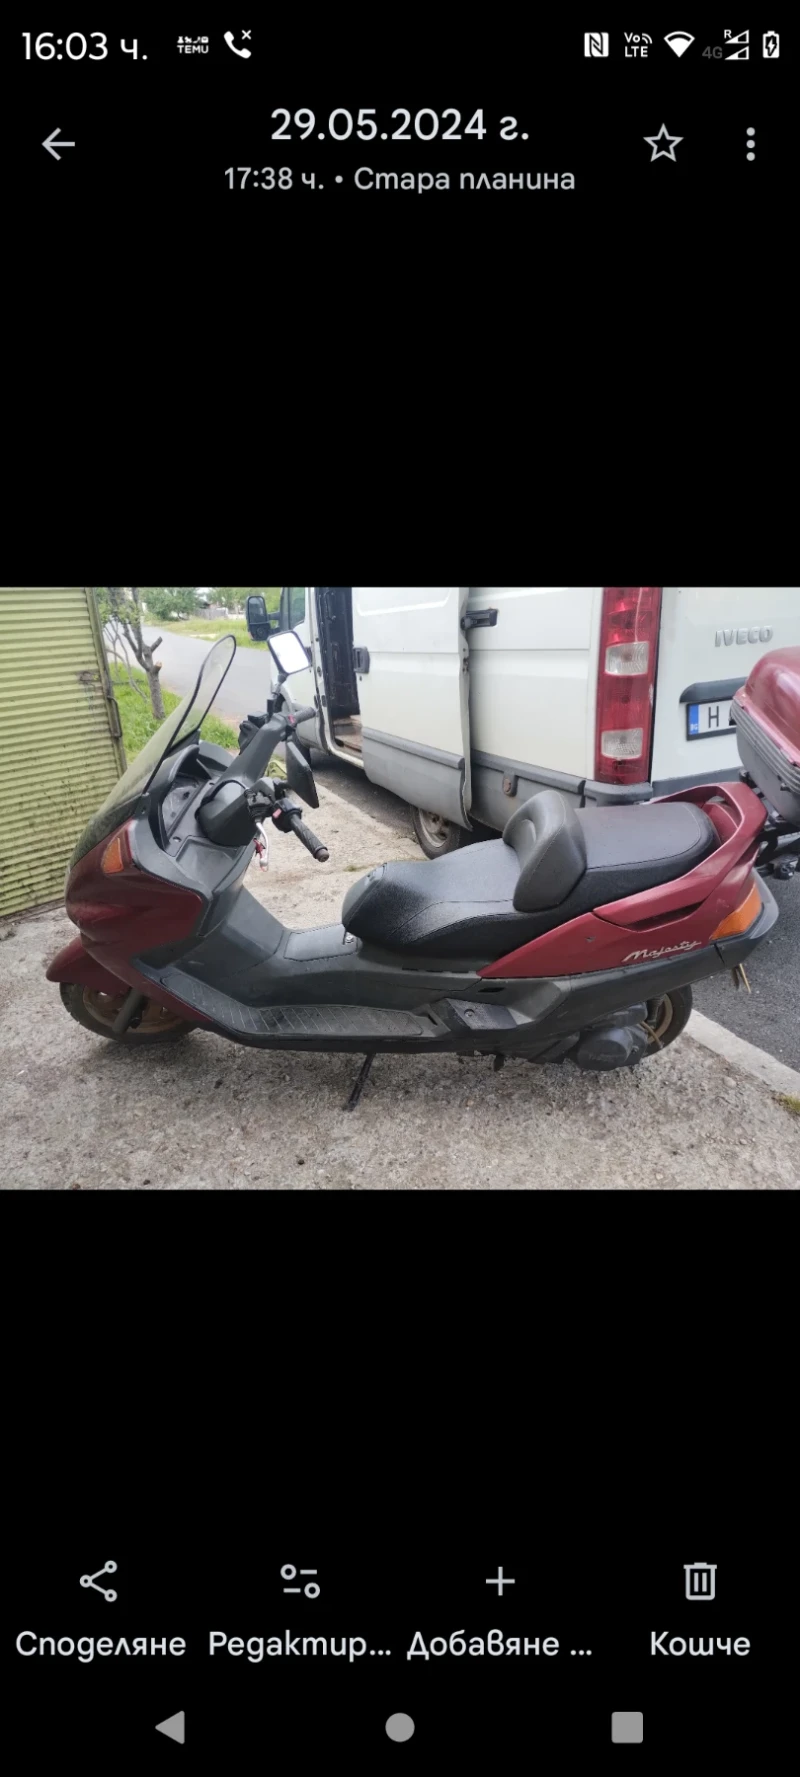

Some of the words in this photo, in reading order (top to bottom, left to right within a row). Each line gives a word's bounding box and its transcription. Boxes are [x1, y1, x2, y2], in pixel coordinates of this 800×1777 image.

[715, 625, 773, 647] IVECO
[709, 706, 720, 728] H
[621, 940, 702, 962] Majesty
